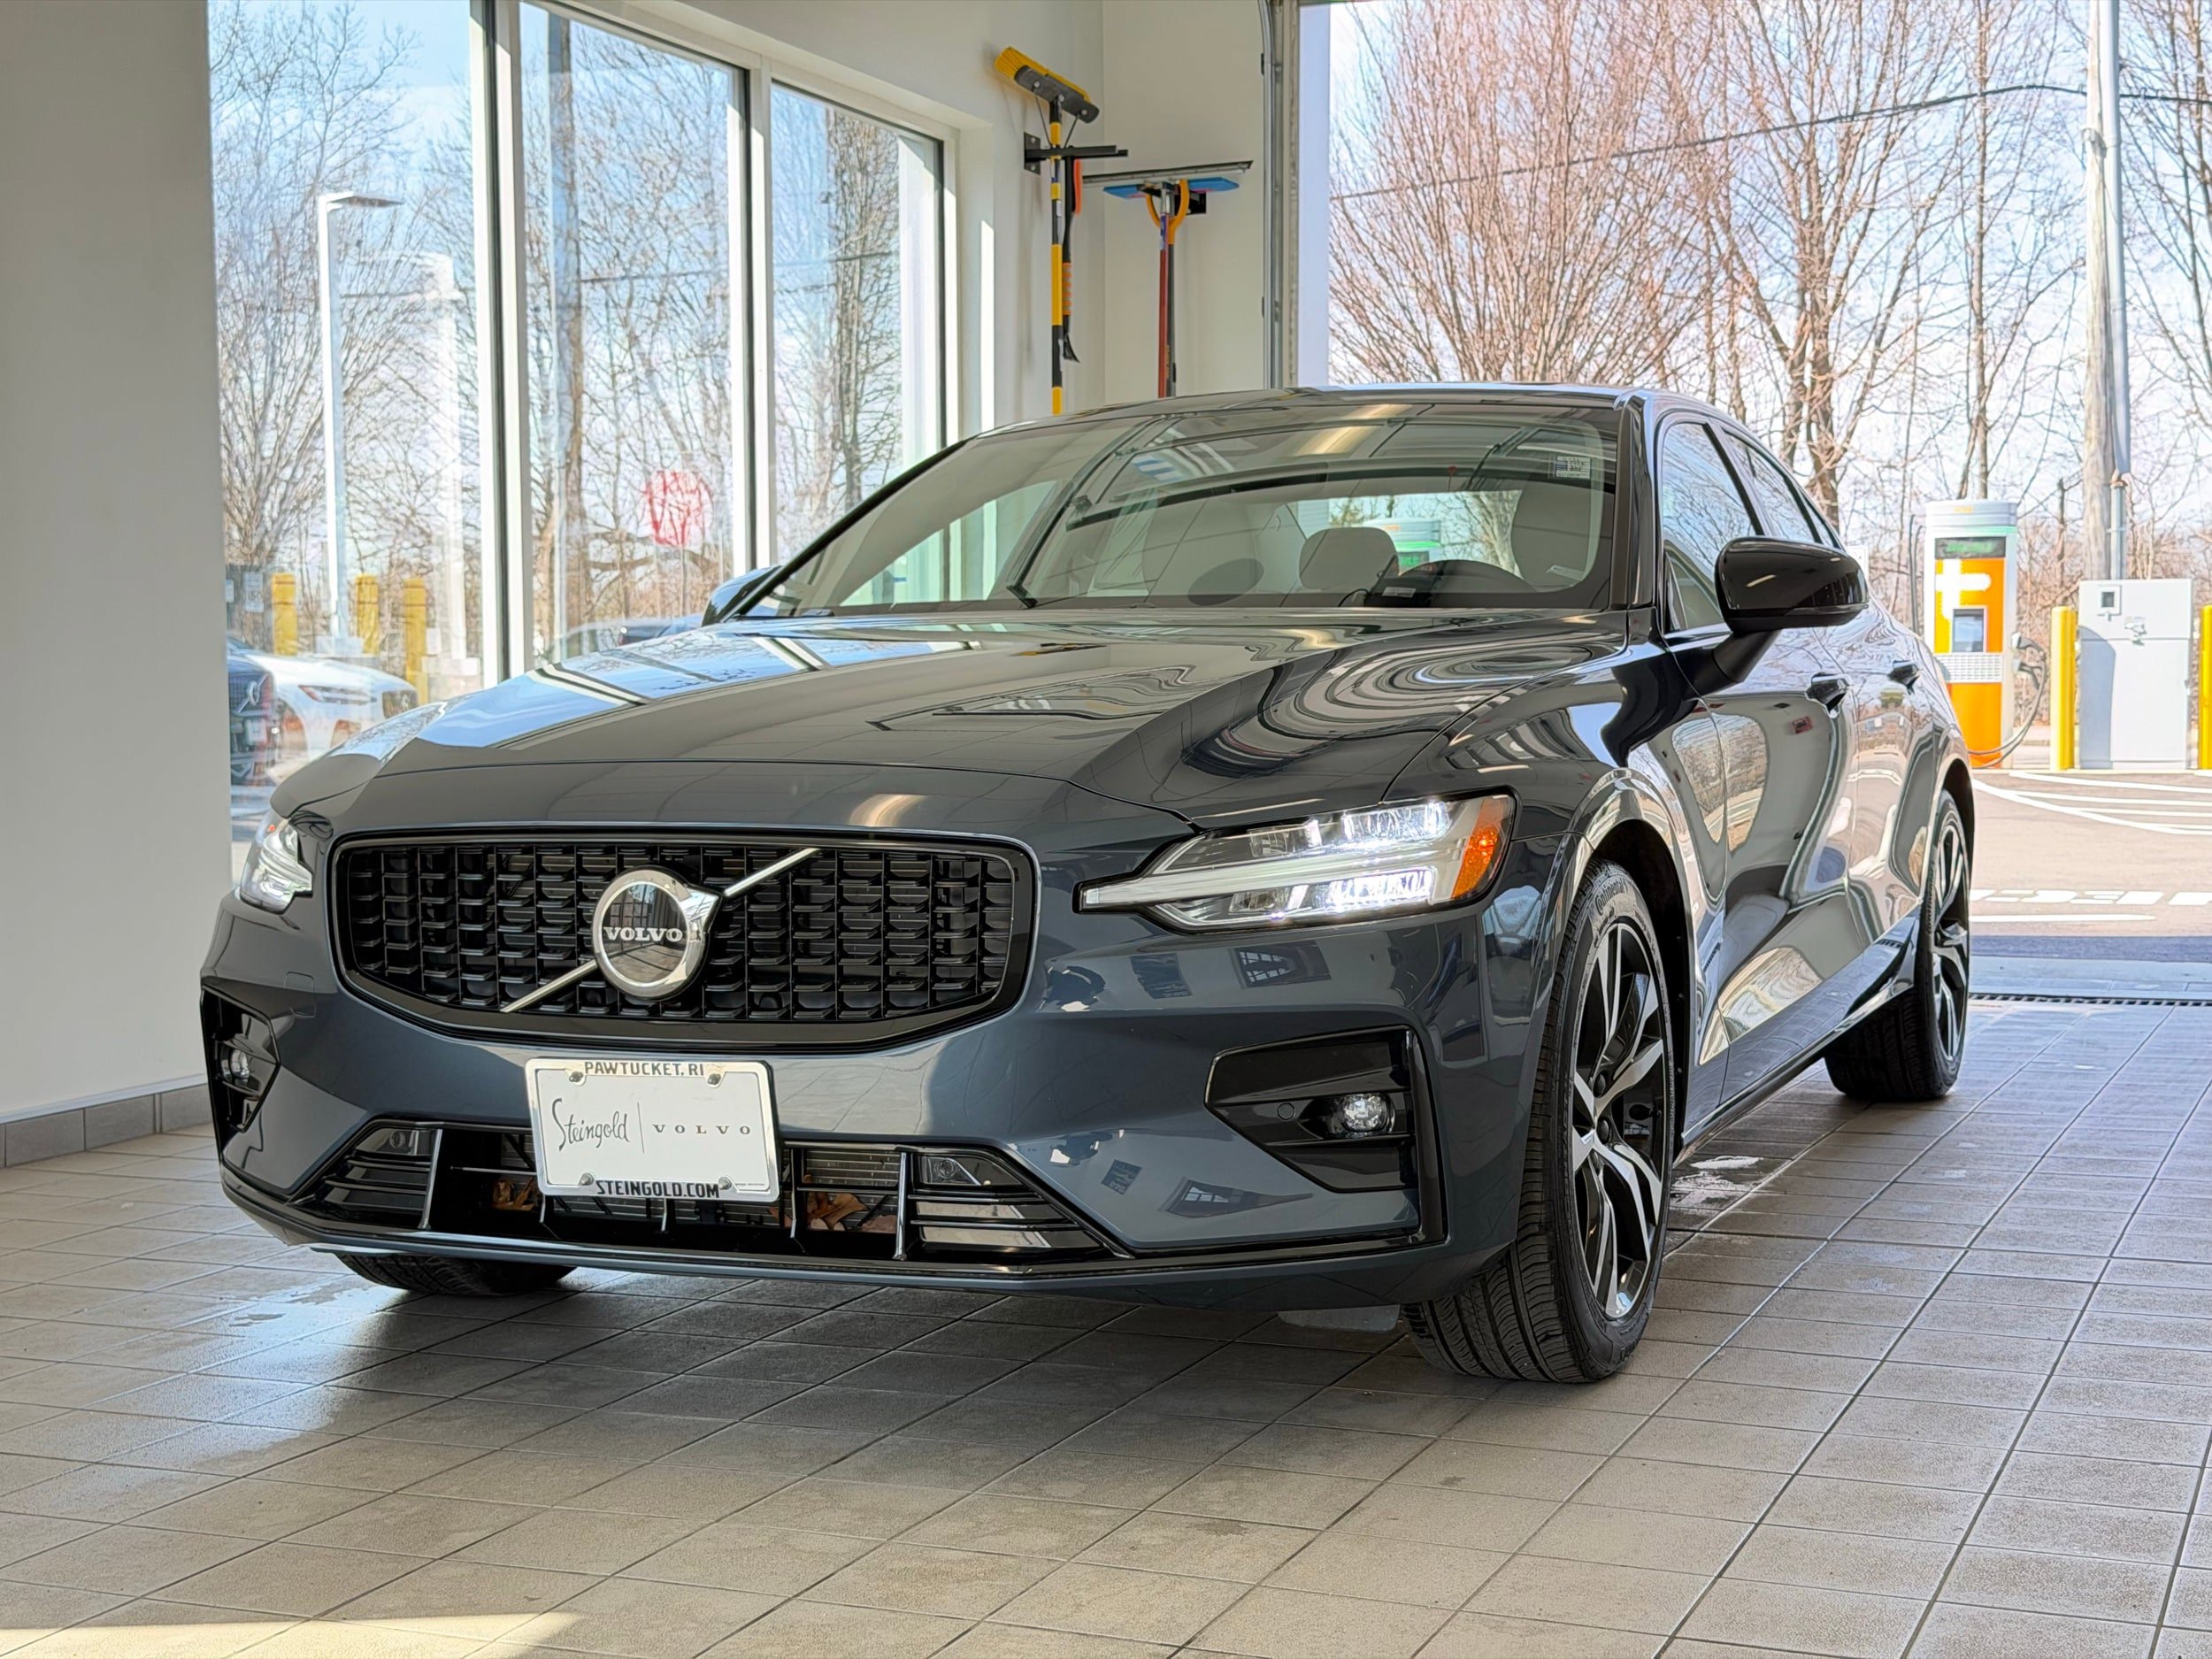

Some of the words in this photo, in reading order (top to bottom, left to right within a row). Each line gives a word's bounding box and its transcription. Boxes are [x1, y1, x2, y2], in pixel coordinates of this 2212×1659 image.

[603, 926, 683, 941] VOLVO
[688, 1064, 704, 1076] RI
[552, 1097, 630, 1151] Steingold
[652, 1124, 751, 1135] VOLVO
[595, 1180, 719, 1198] STEINGOLD.COM
